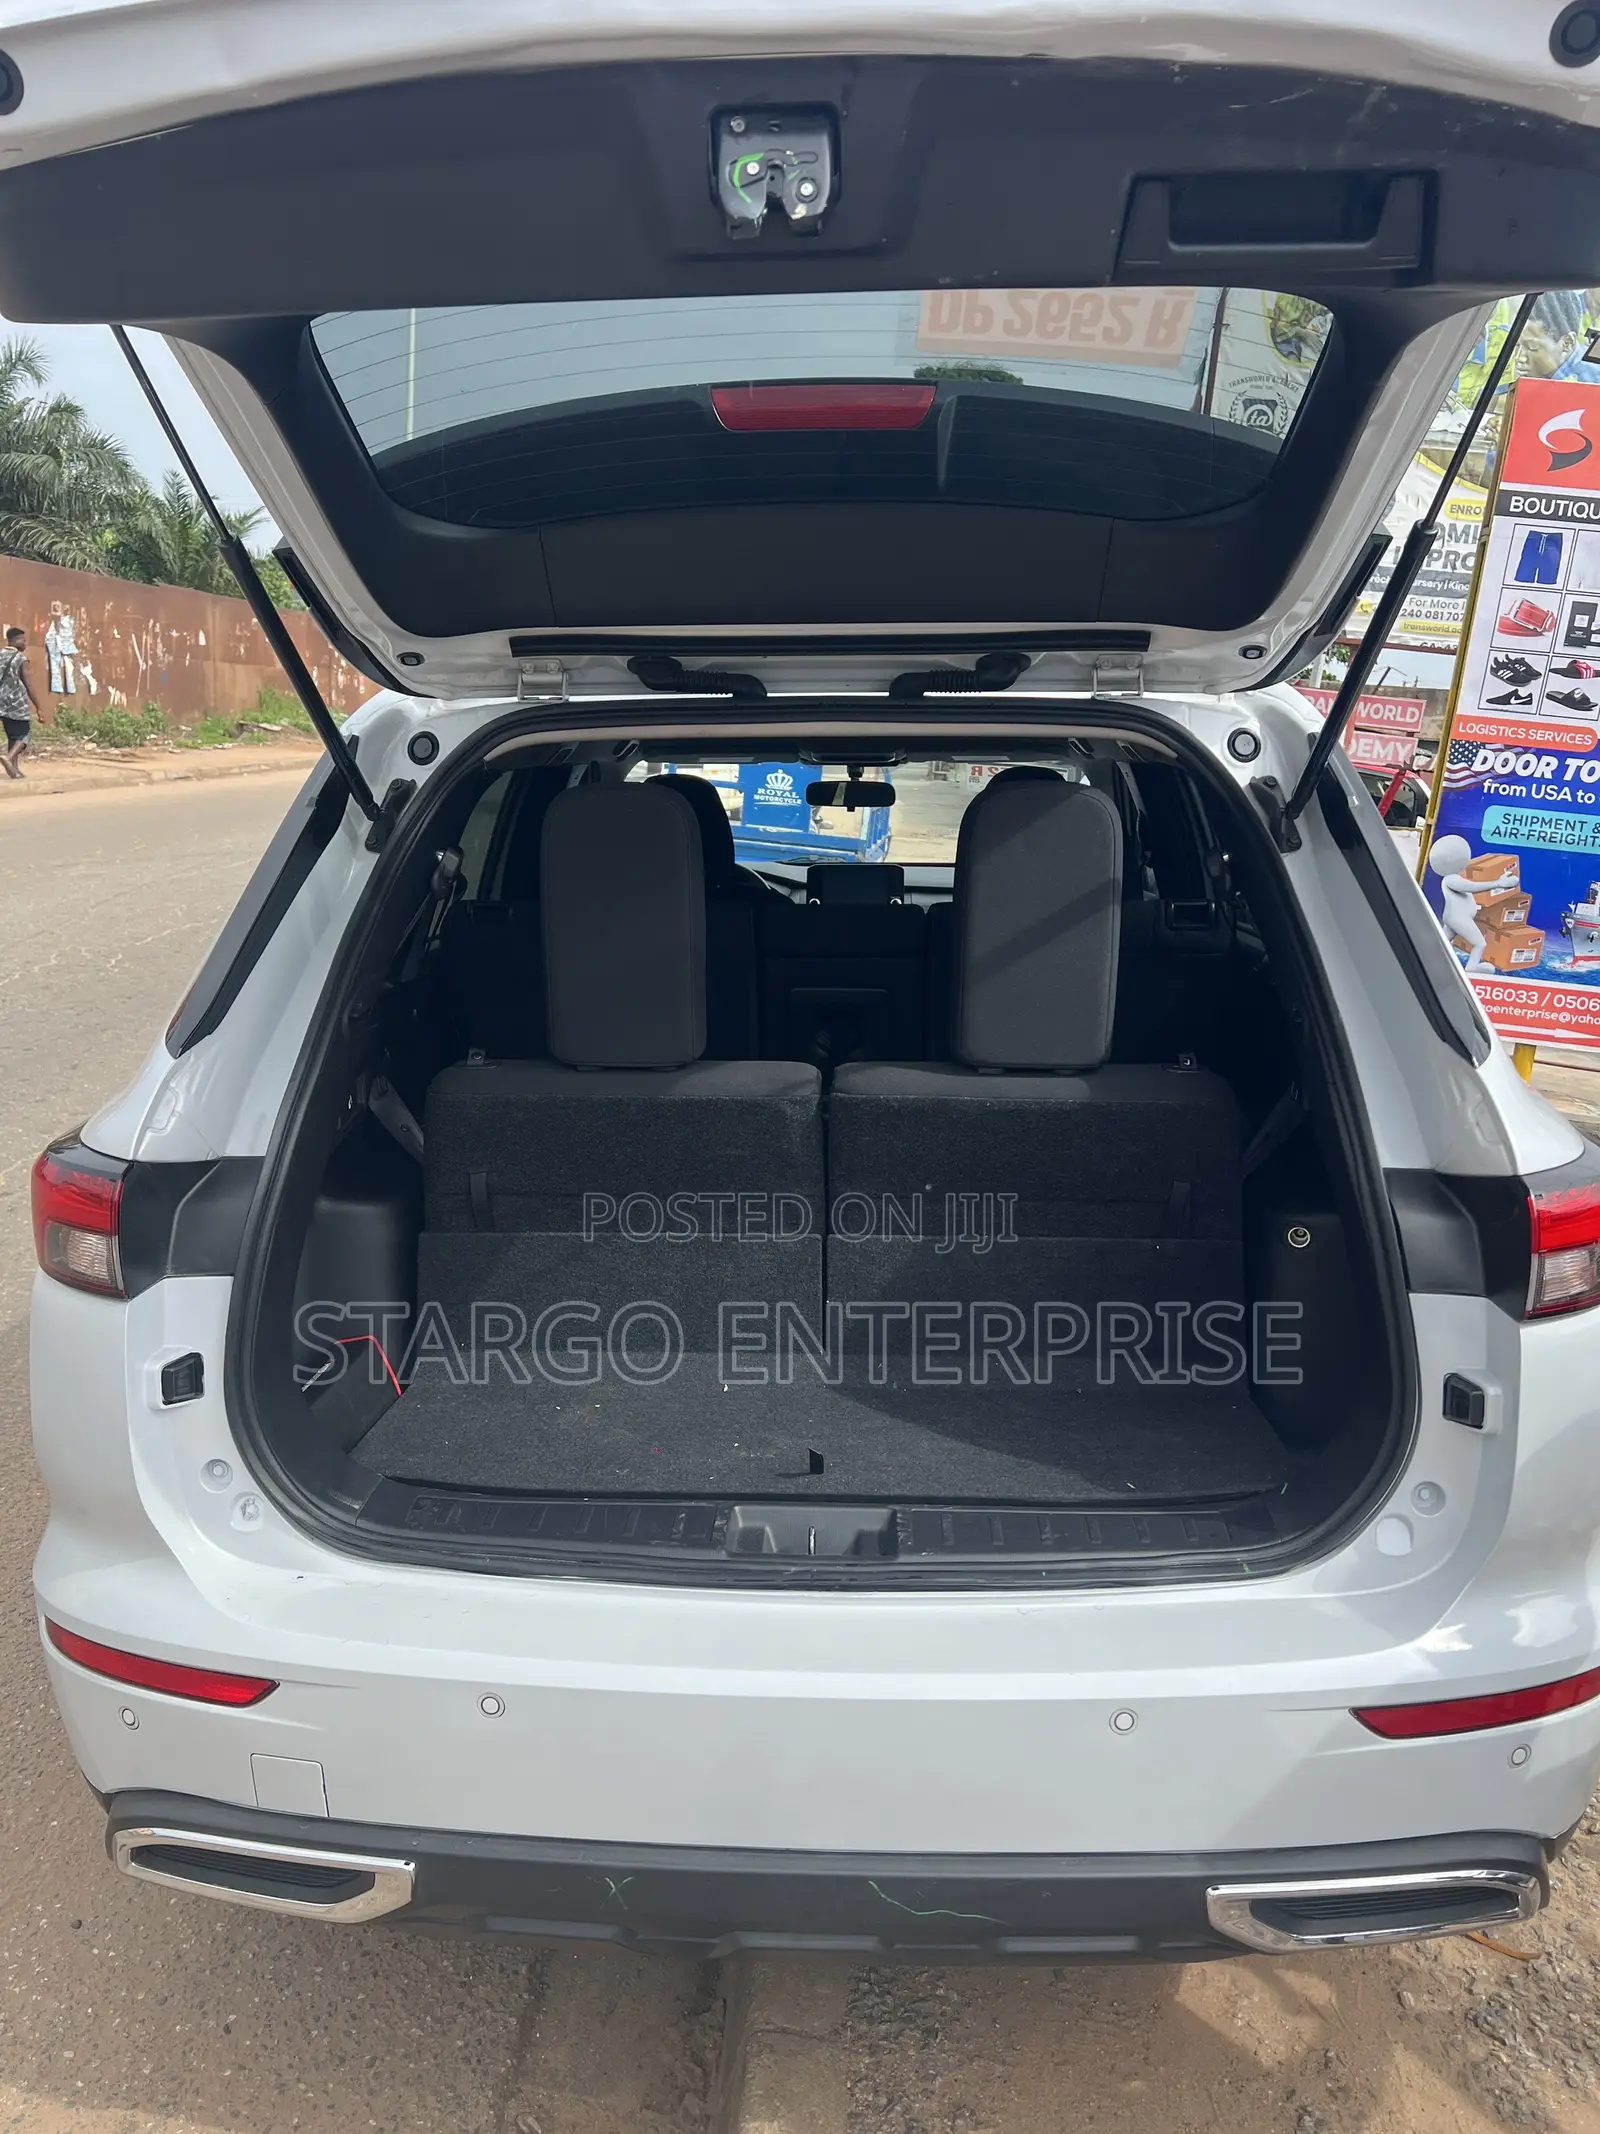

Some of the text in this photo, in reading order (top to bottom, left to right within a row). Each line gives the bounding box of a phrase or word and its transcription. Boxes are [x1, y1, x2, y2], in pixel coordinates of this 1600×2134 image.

[1408, 597, 1428, 608] For
[1429, 599, 1460, 610] More
[1458, 722, 1593, 746] LOGISTICS SERVICES
[1470, 748, 1600, 784] DOOR TO
[753, 794, 802, 805] MOTORCYCLE
[757, 788, 800, 799] ROYAL
[1482, 779, 1596, 804] from USA to
[1501, 813, 1588, 833] SHIPMENT
